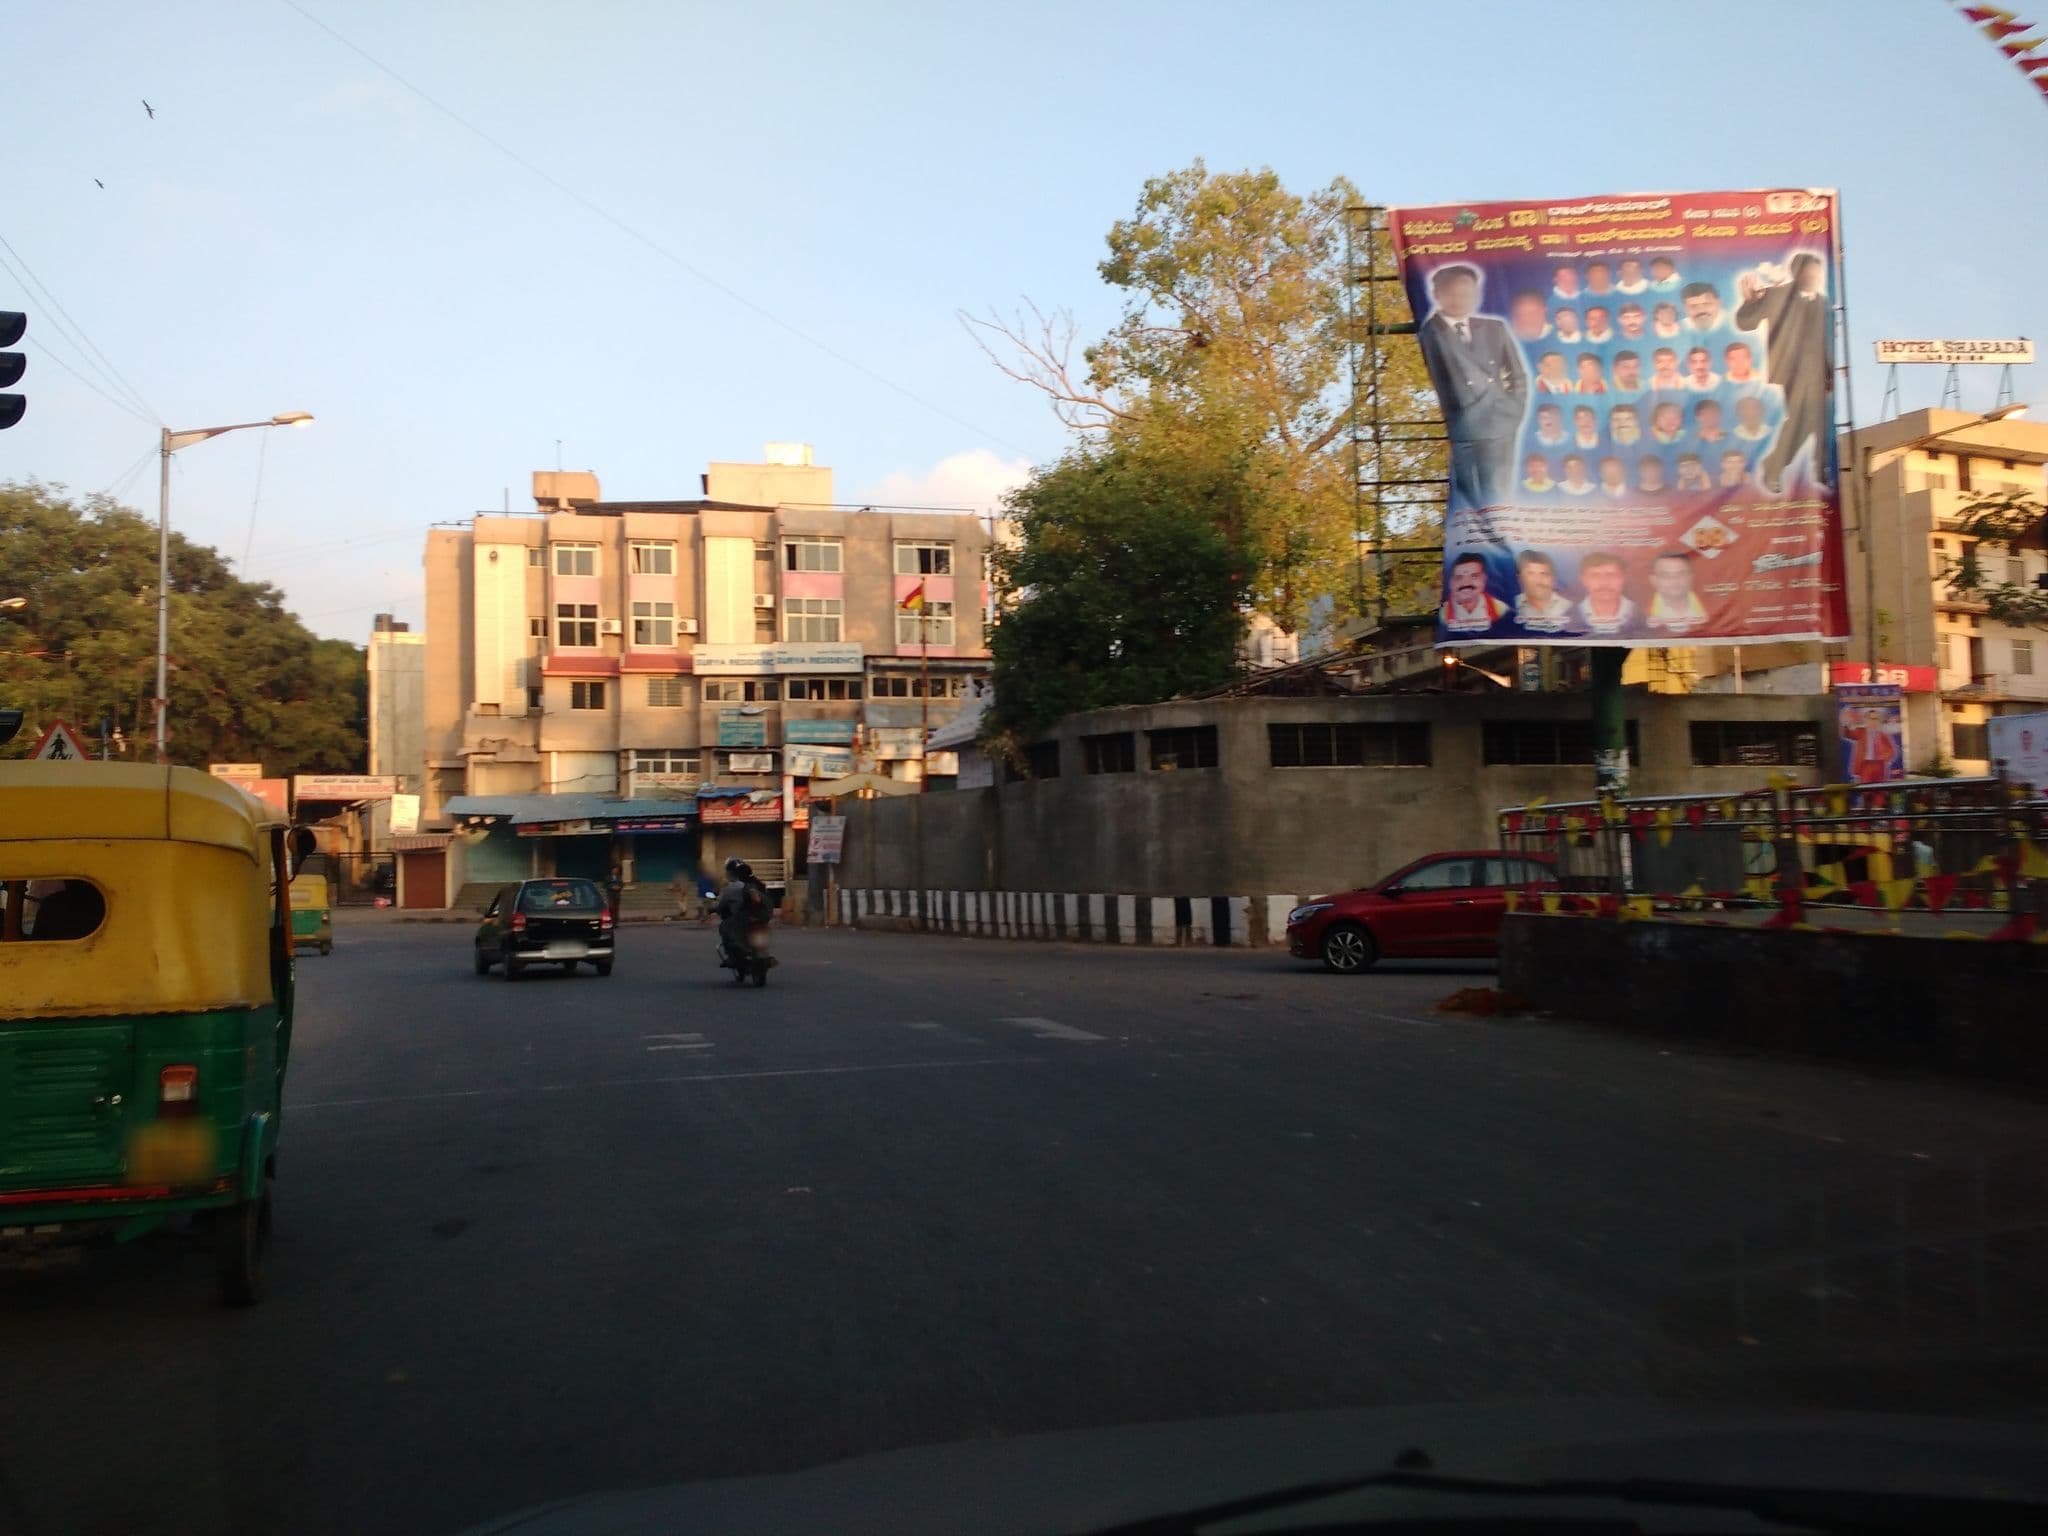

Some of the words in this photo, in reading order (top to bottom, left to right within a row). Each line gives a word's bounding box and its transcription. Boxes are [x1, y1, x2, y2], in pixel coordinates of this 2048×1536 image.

[1882, 341, 1939, 353] HOTEL
[1944, 341, 2028, 354] SHARADA
[729, 658, 774, 666] RESIDENC
